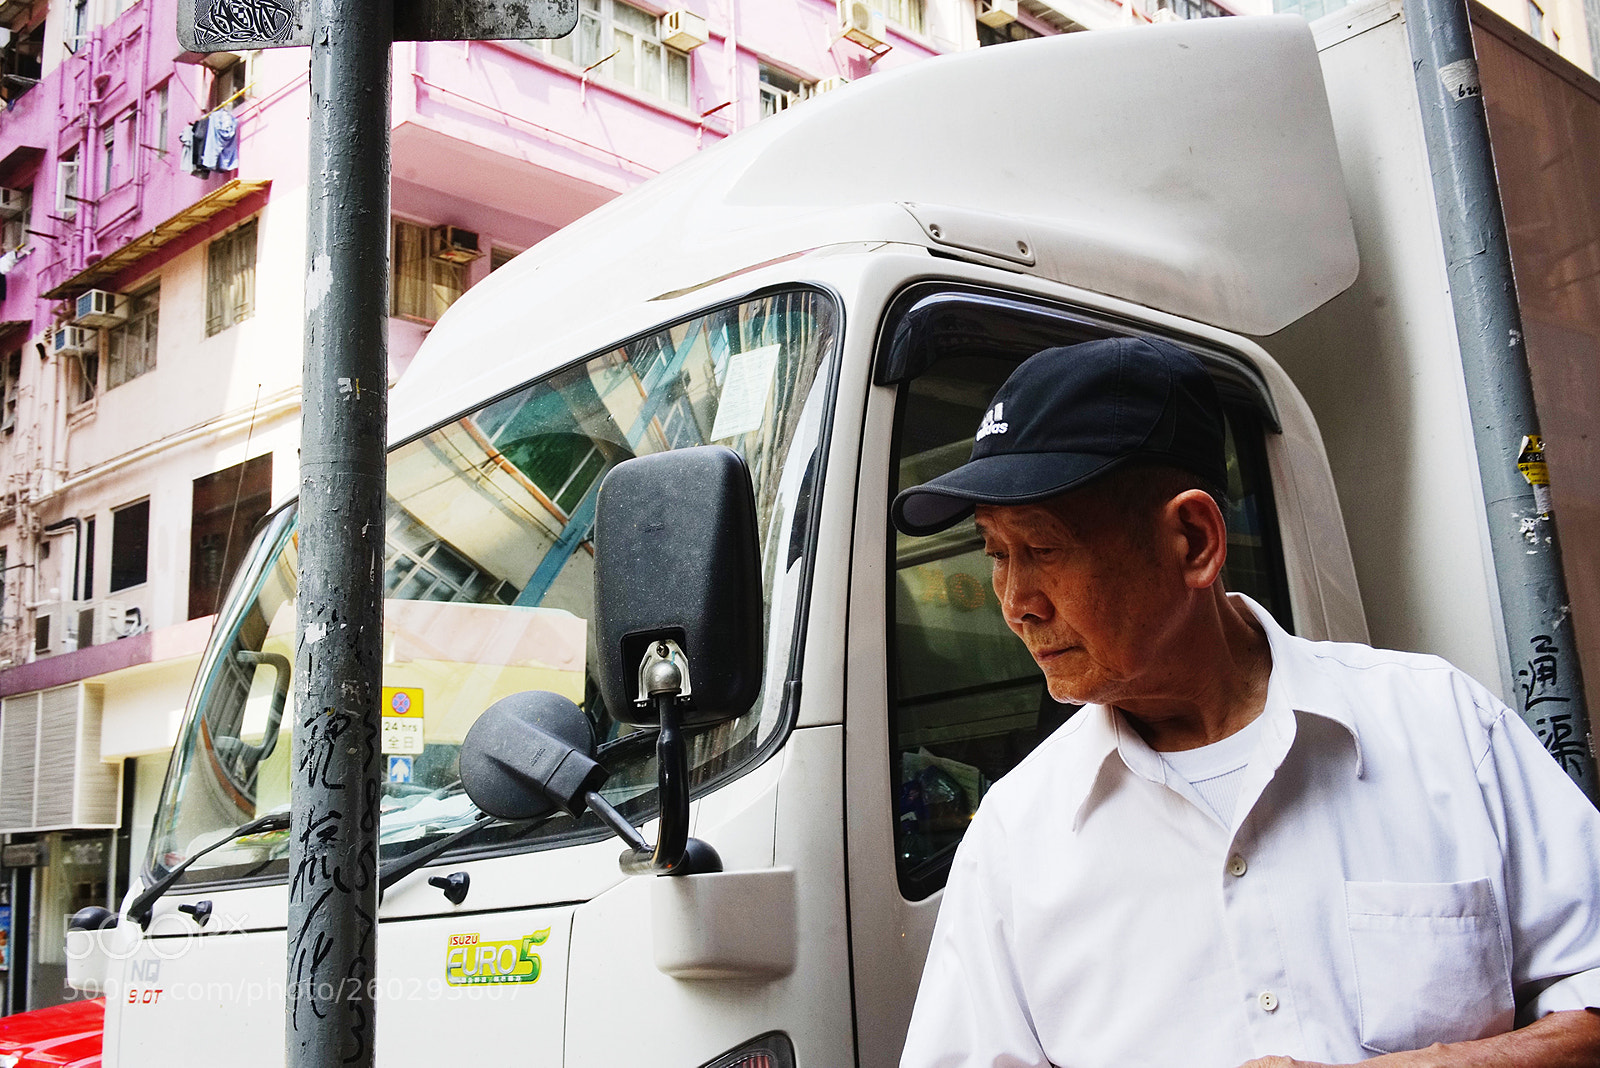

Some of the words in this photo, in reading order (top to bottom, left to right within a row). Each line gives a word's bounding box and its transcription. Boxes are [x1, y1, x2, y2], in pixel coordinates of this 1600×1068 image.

[1518, 634, 1586, 778] 通渠
[385, 721, 398, 731] 24
[402, 721, 418, 732] hrs
[388, 736, 414, 749] 全日
[449, 935, 478, 946] ISUZU
[130, 959, 161, 983] NQ
[128, 989, 163, 1004] 9.0T
